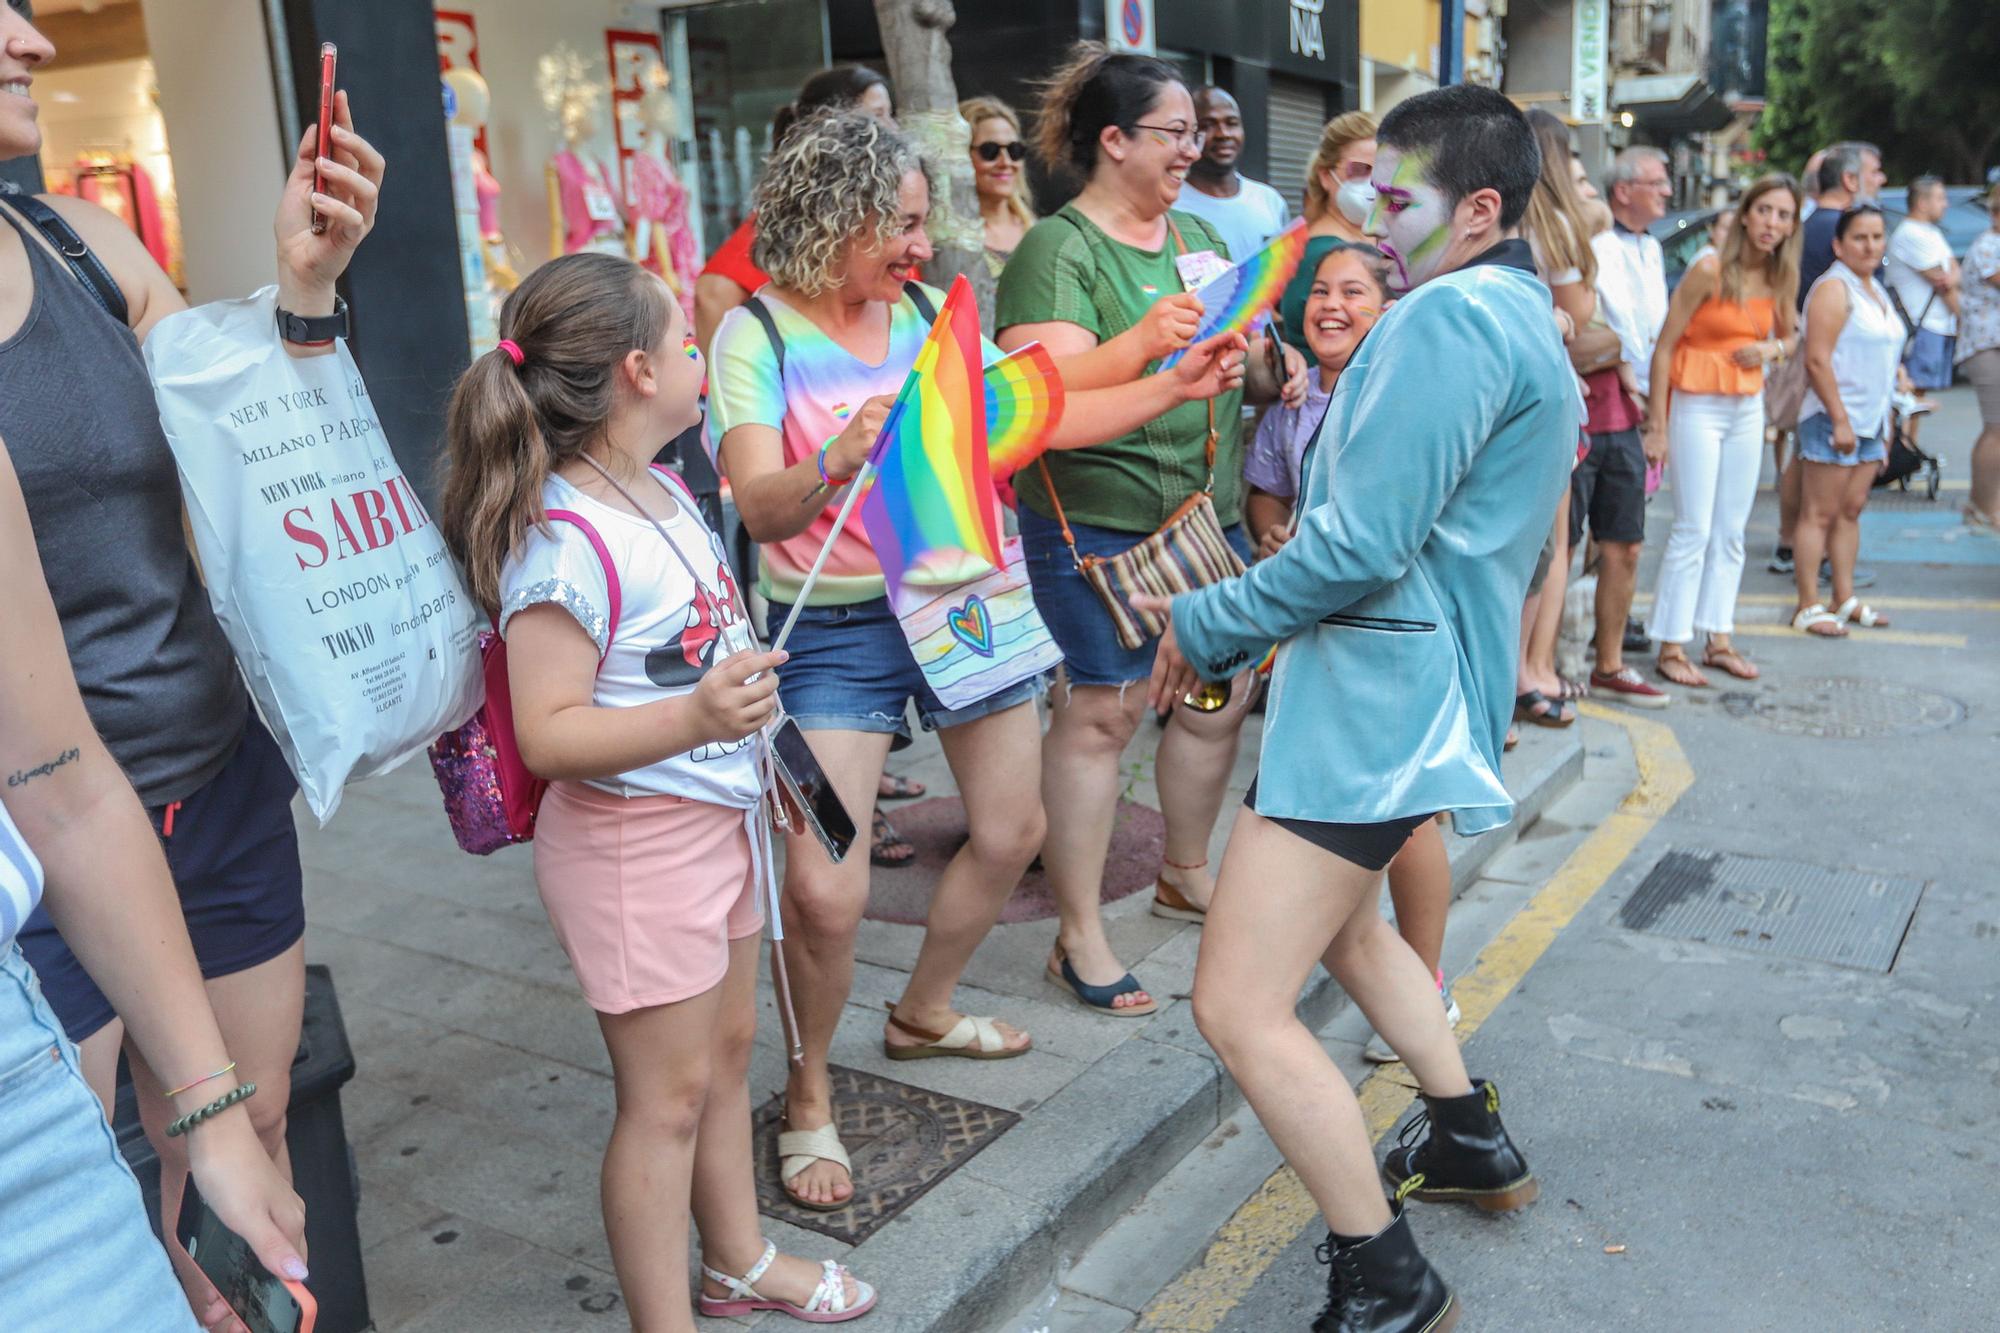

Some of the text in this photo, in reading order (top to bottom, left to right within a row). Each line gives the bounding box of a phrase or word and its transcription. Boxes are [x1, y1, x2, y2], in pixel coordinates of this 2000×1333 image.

[230, 400, 270, 428] NEW
[278, 387, 328, 413] YORK
[242, 434, 316, 466] MILANO
[260, 480, 291, 505] NEW
[291, 470, 327, 496] YORK
[331, 471, 366, 487] milano
[306, 573, 391, 615] LONDON
[321, 622, 375, 660] TOKYO
[390, 612, 426, 637] london
[421, 589, 456, 624] paris
[376, 694, 402, 713] ALICANTE
